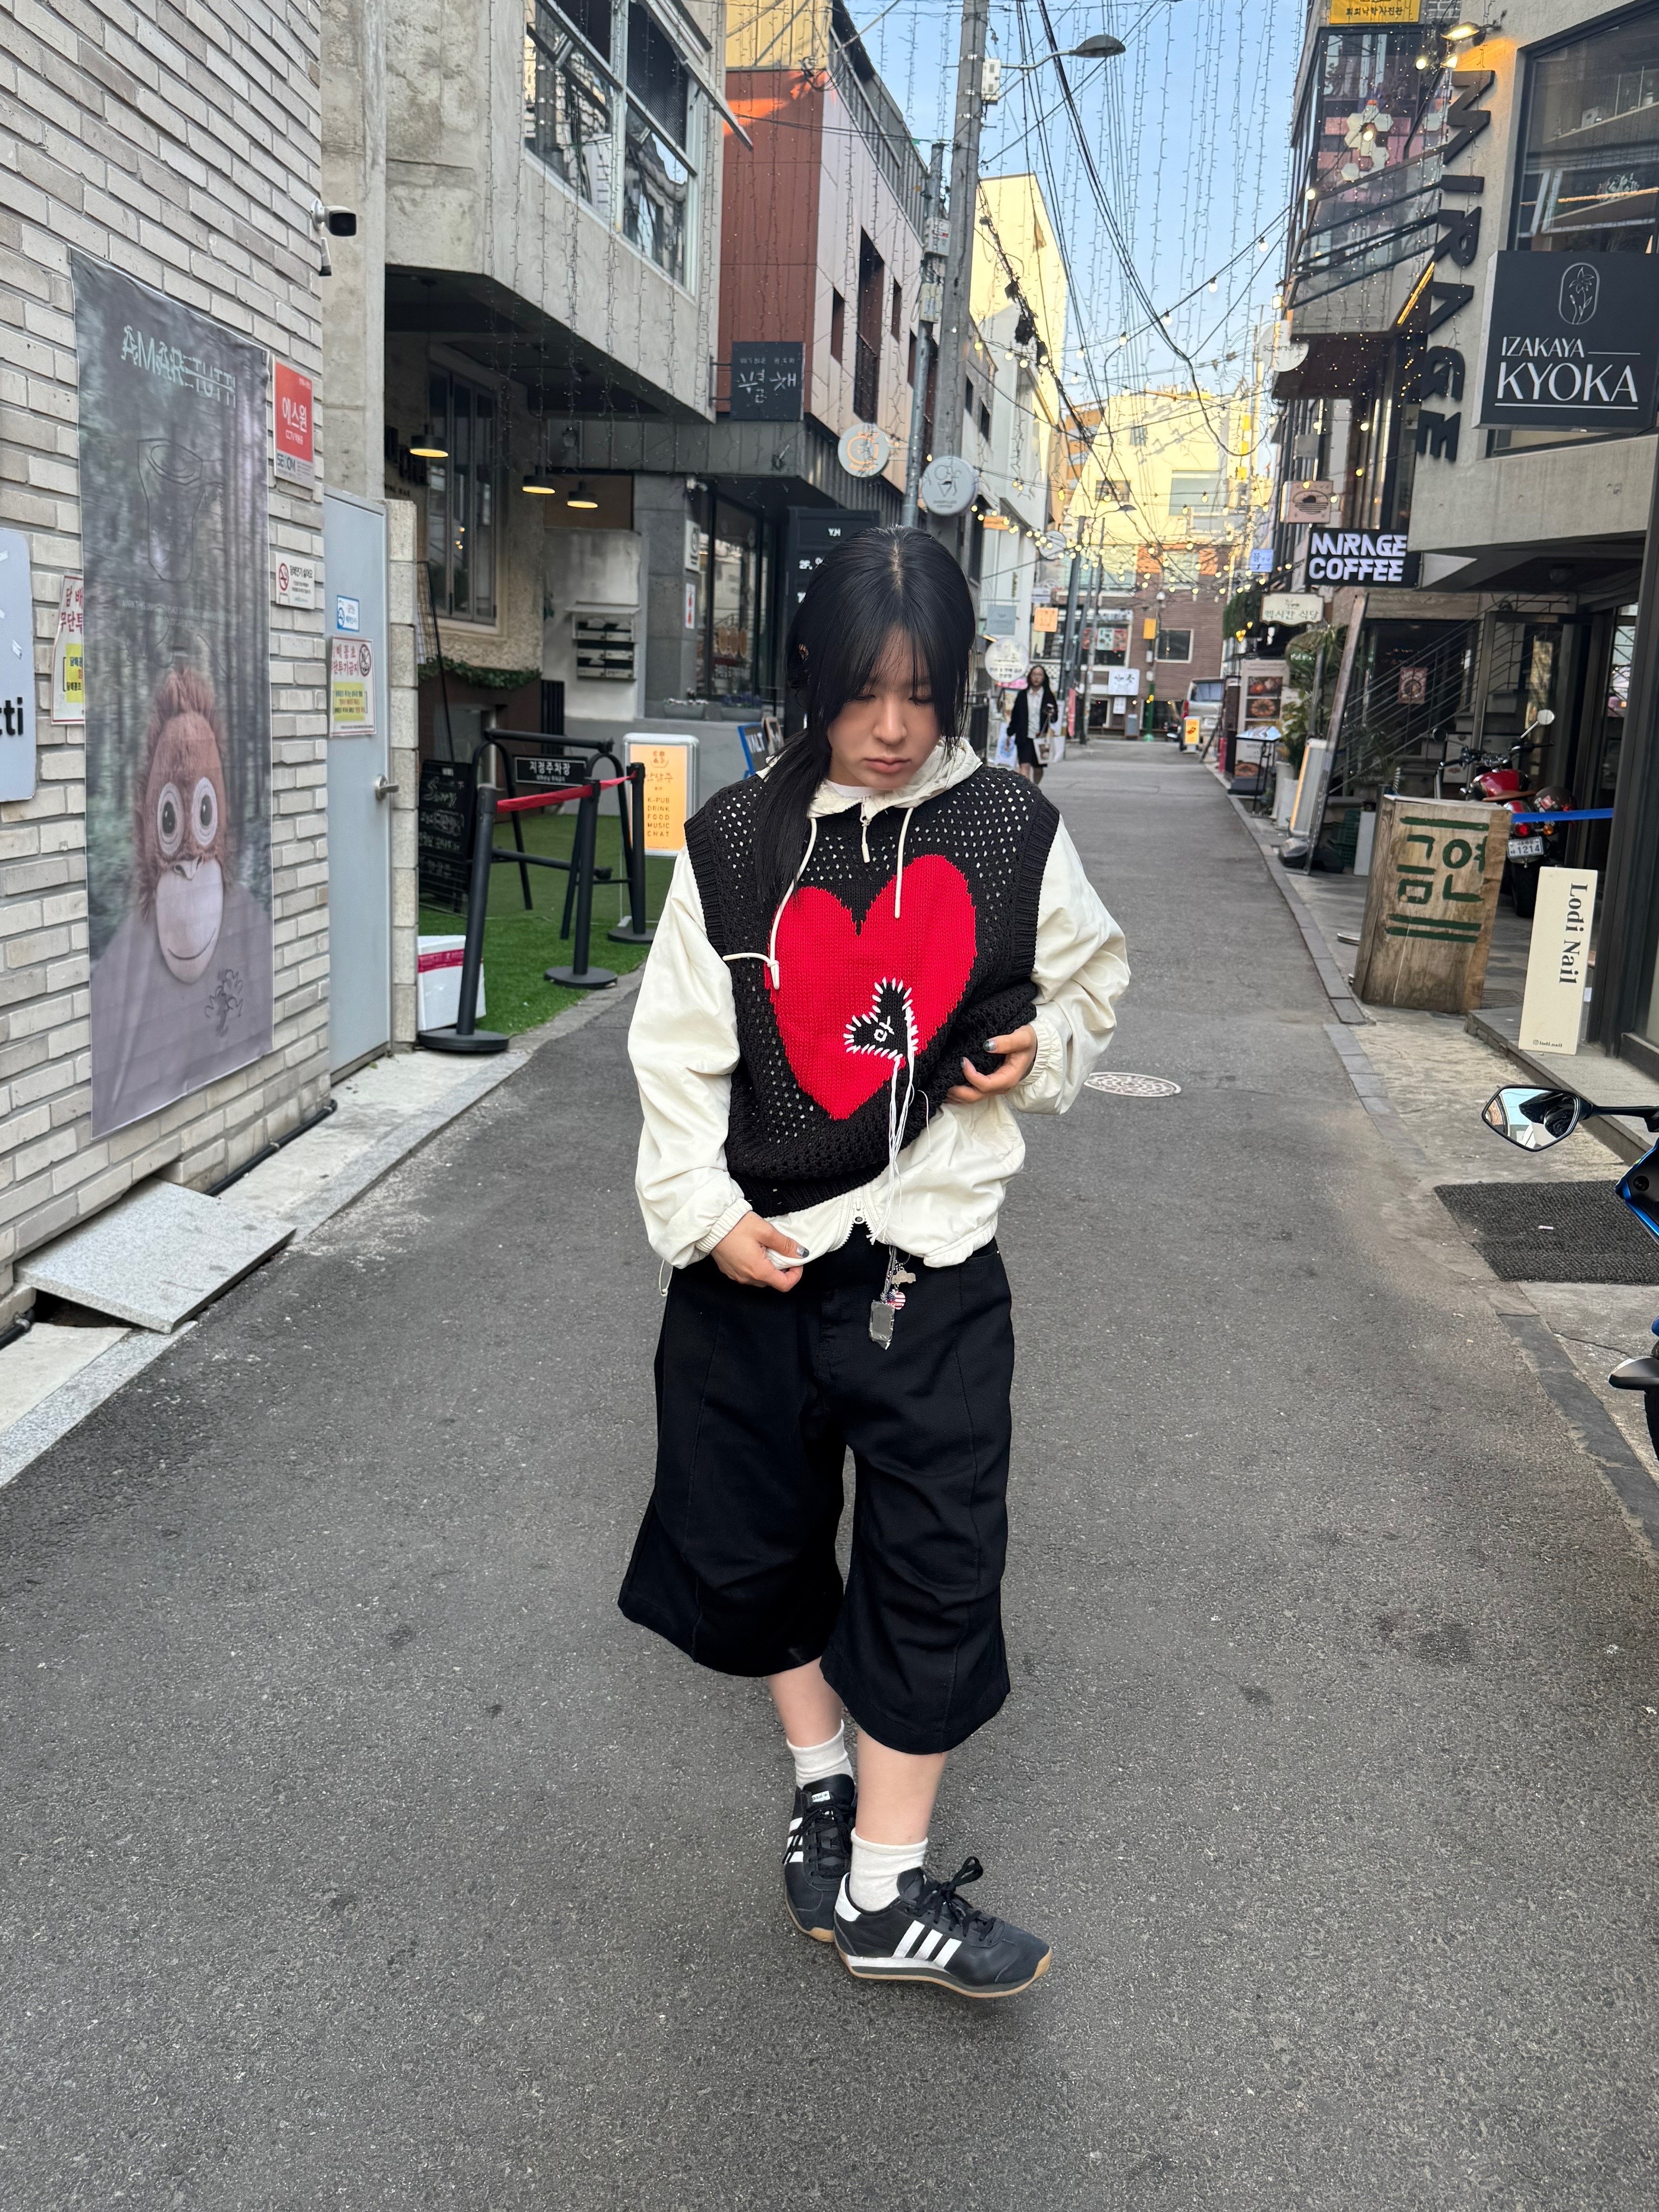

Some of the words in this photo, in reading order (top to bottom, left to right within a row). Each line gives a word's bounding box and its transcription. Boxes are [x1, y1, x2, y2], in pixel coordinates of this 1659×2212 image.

[1417, 70, 1495, 462] MIRAGE
[1501, 337, 1585, 358] IZAKAYA
[1497, 362, 1638, 403] KYOKA
[282, 397, 307, 434] 에스원
[1311, 532, 1408, 557] MIRAGE
[1309, 557, 1405, 582] COFFEE
[529, 761, 570, 776] 지정주차장
[1517, 844, 1541, 855] 1214
[1396, 834, 1488, 905] 금연
[1565, 883, 1588, 931] Lodi
[1559, 939, 1581, 984] Nail
